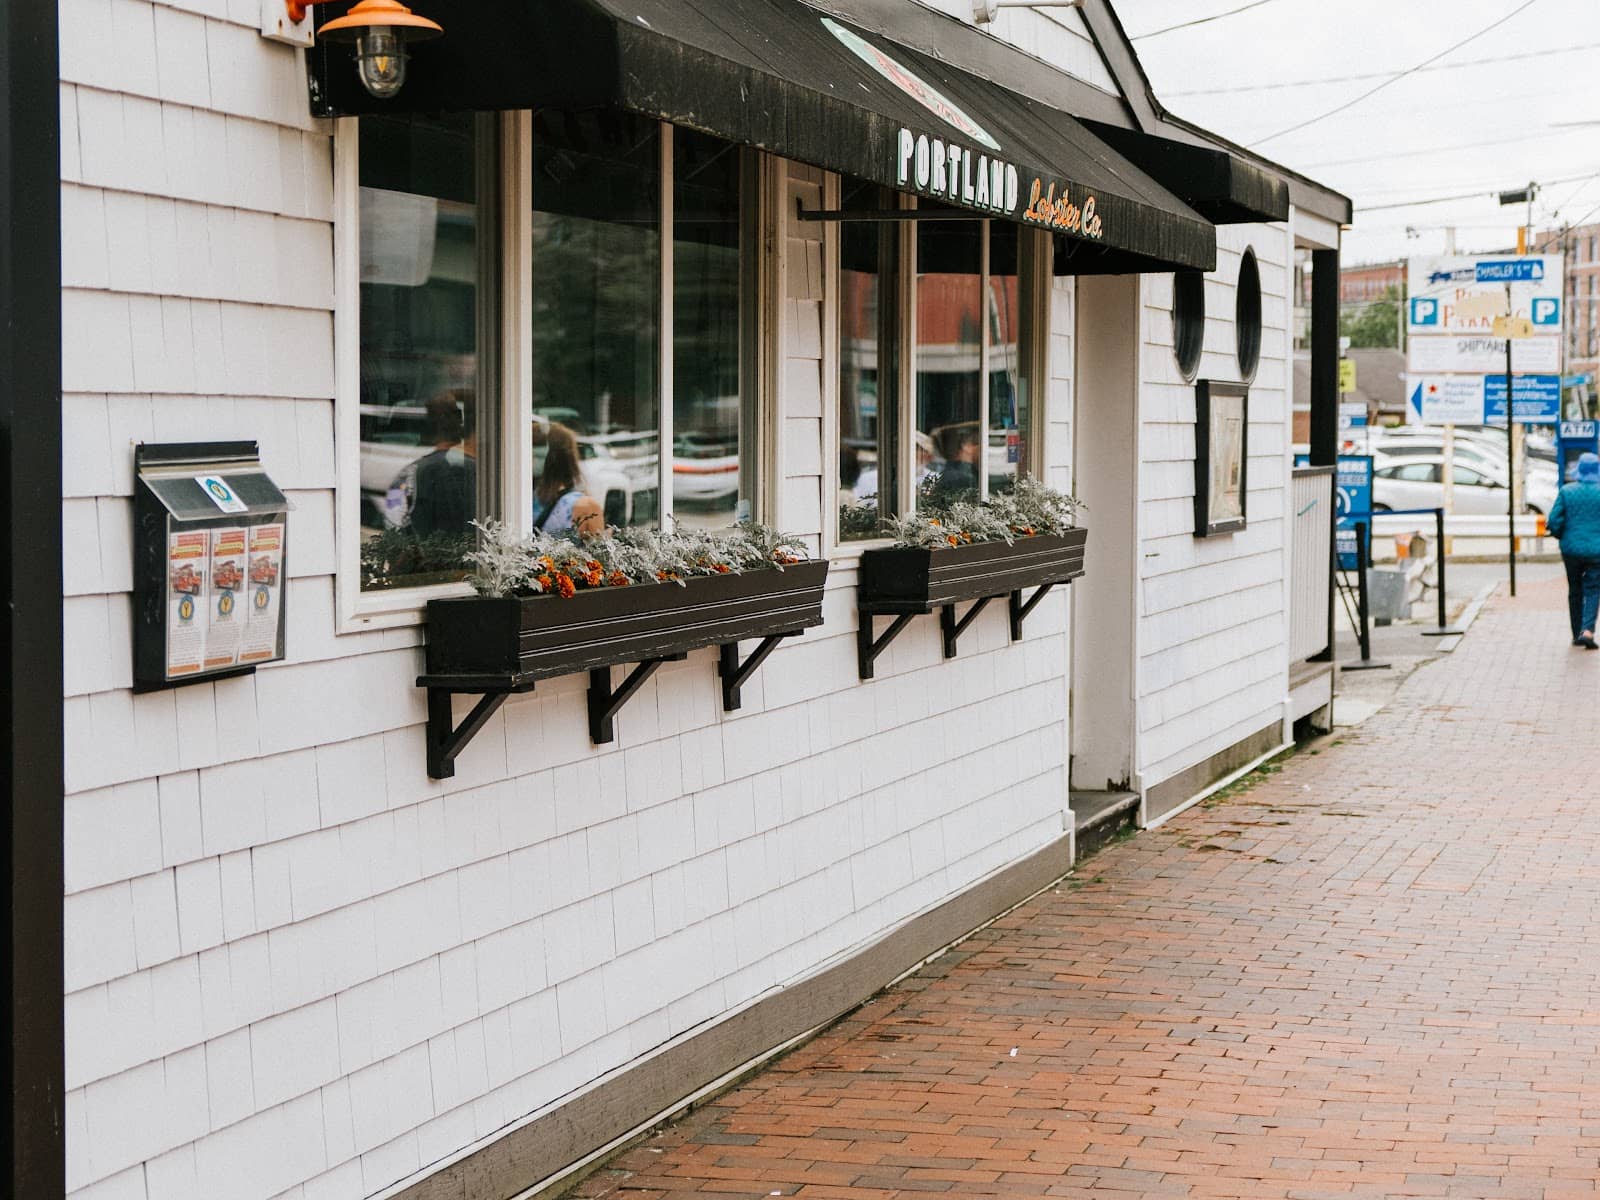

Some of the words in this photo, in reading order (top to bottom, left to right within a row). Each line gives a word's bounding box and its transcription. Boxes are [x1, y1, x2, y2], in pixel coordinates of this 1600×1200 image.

[898, 127, 1018, 215] PORTLAND
[1023, 177, 1081, 233] Lobster
[1081, 196, 1103, 239] Co.
[1415, 300, 1435, 323] P
[1537, 300, 1556, 322] P
[1563, 425, 1594, 435] ATM
